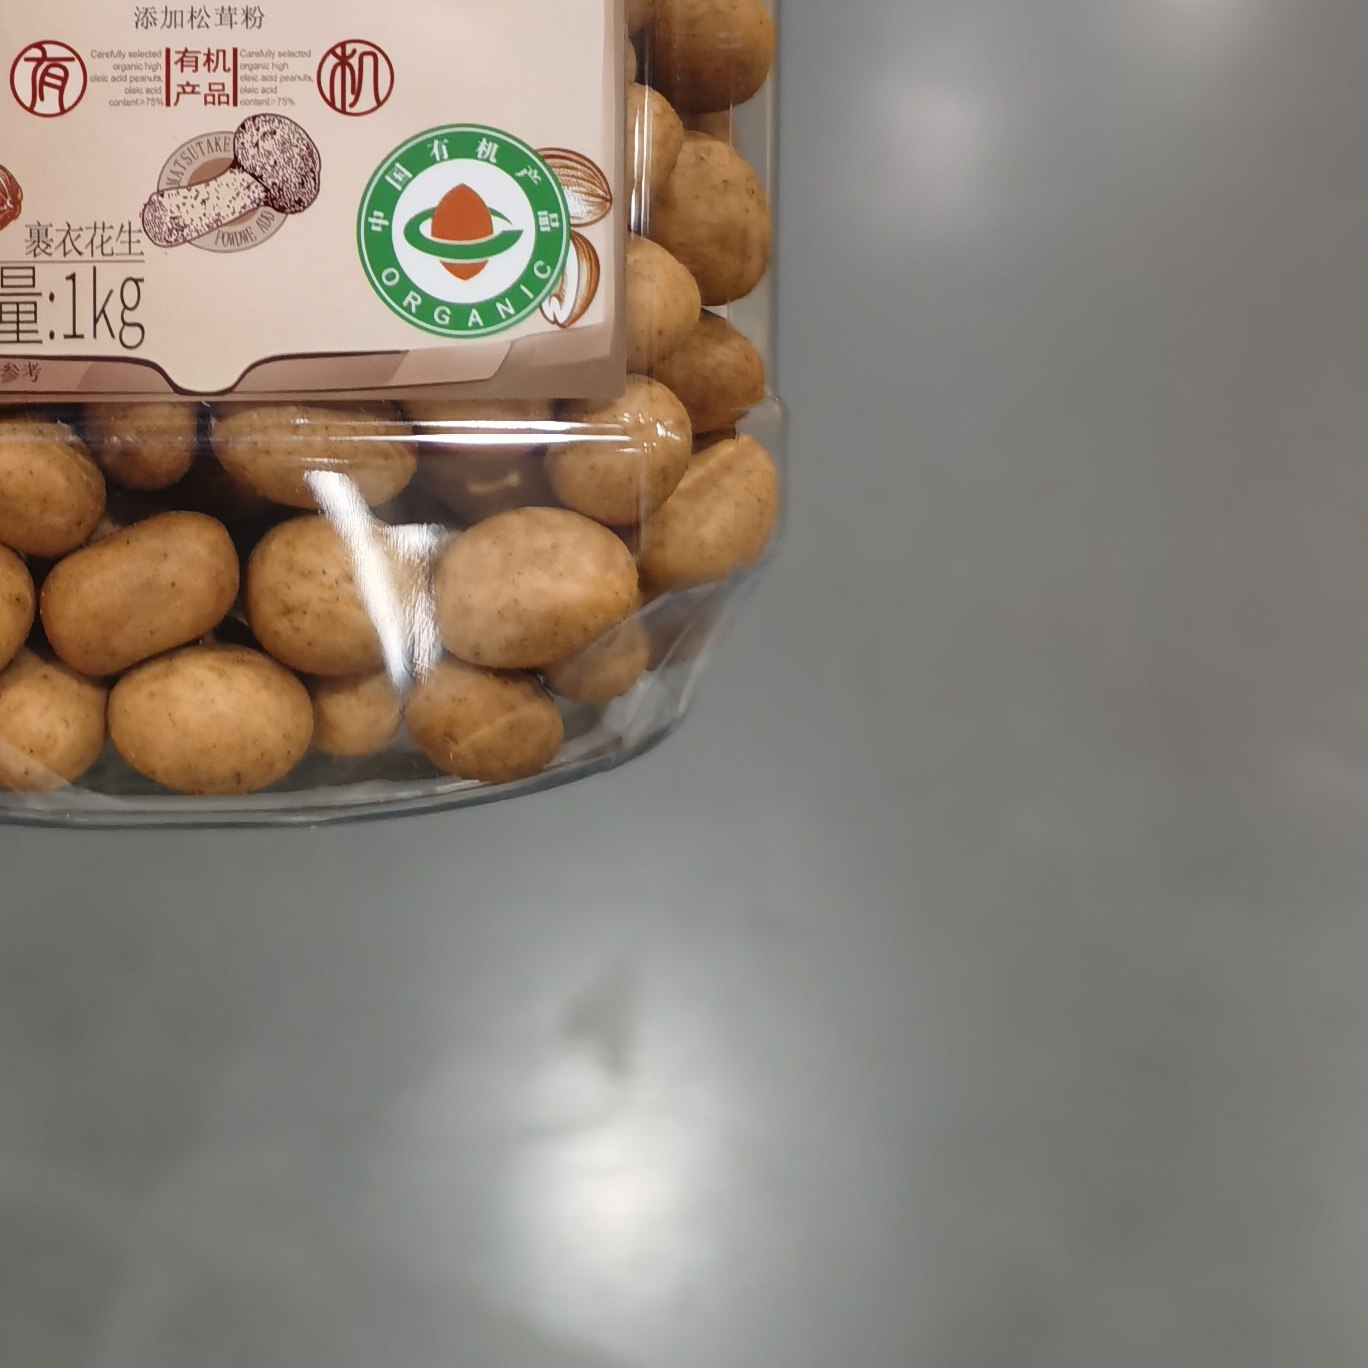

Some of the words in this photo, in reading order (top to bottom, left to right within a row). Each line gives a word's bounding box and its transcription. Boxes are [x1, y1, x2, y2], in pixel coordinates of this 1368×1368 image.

[133, 5, 266, 30] 添加松茸粉
[173, 46, 231, 74] 有机
[173, 81, 231, 107] 产品
[165, 136, 232, 187] MATSUTAKE
[368, 138, 560, 232] 中国有机产品
[24, 221, 145, 258] 裹衣花生
[381, 260, 551, 328] ORGANIC
